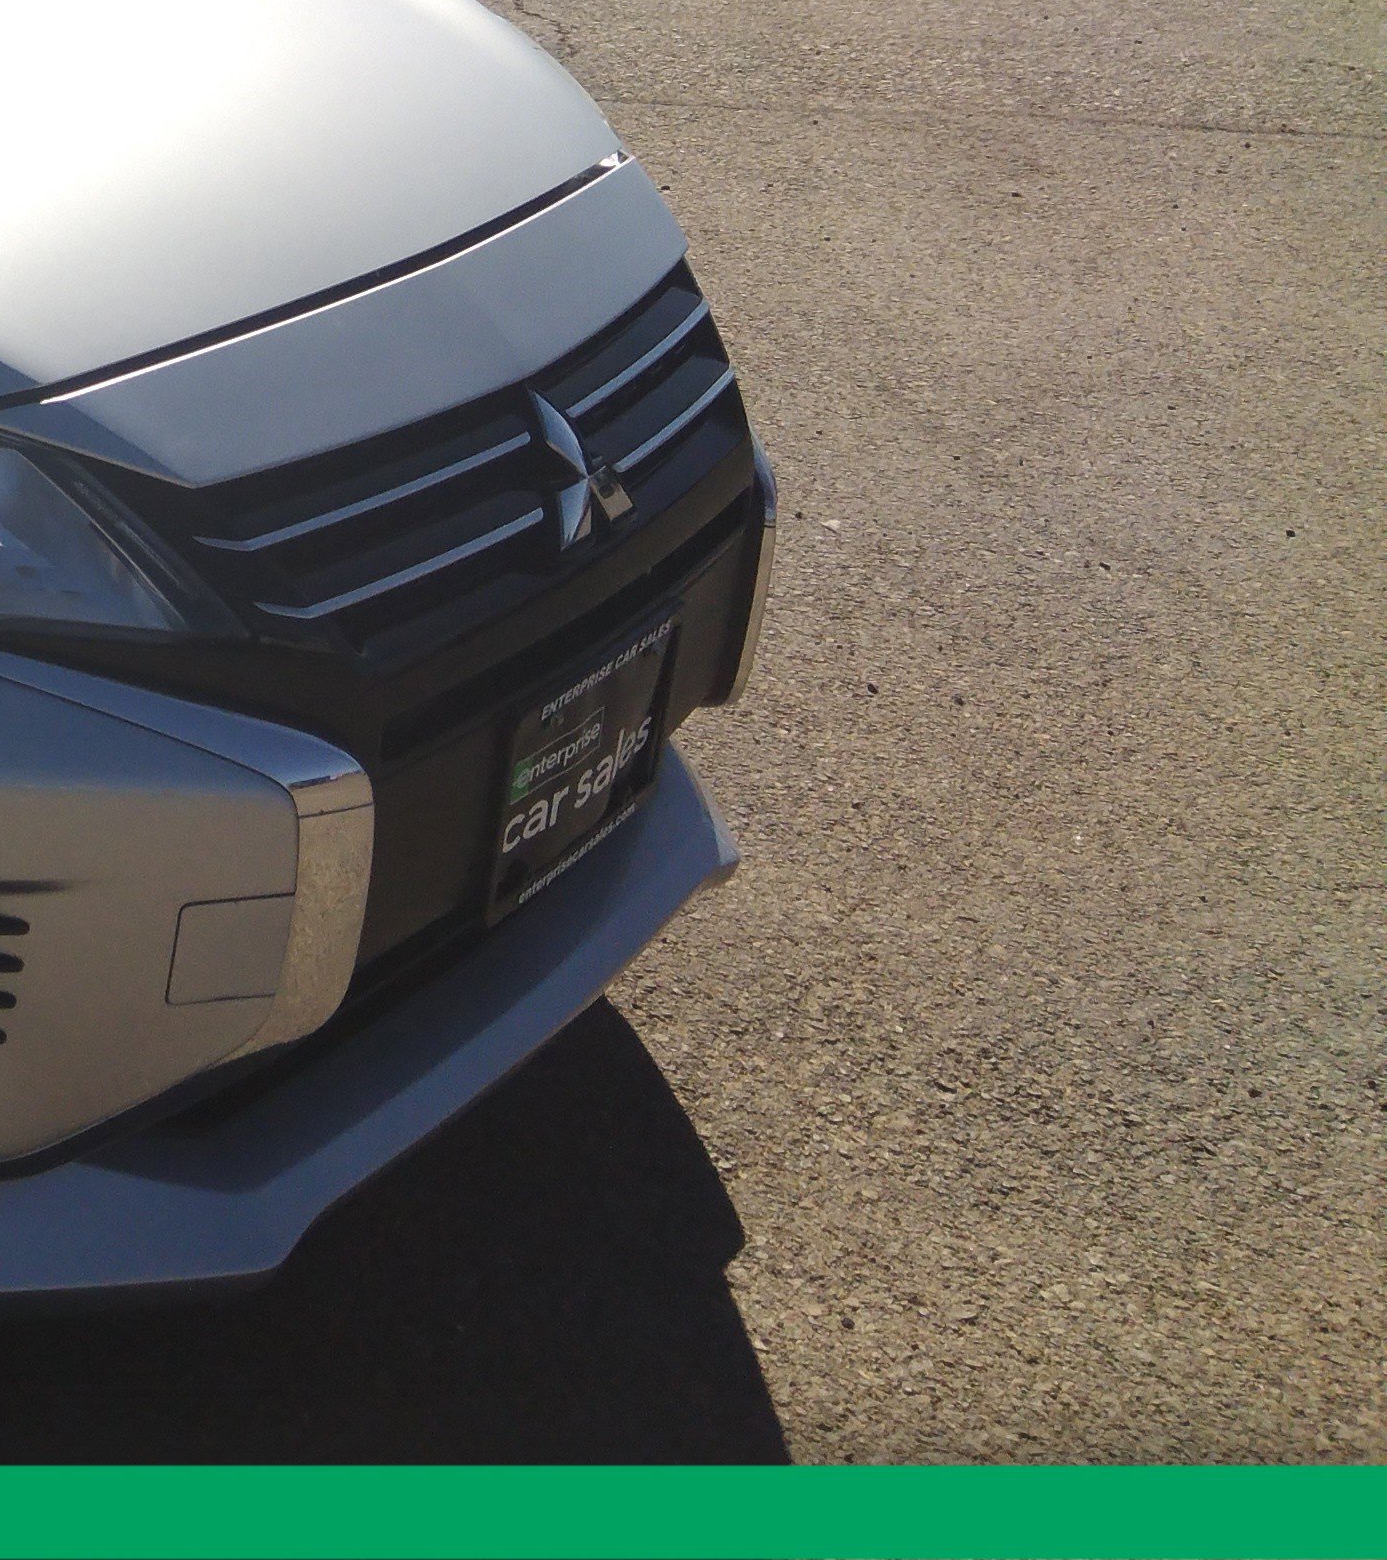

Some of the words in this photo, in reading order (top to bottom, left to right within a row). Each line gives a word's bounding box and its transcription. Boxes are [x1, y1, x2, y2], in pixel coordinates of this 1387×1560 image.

[541, 660, 614, 721] ENTERPRISE
[615, 642, 639, 670] CAR
[502, 785, 570, 853] car
[574, 716, 652, 809] sales
[516, 722, 600, 788] enterprise
